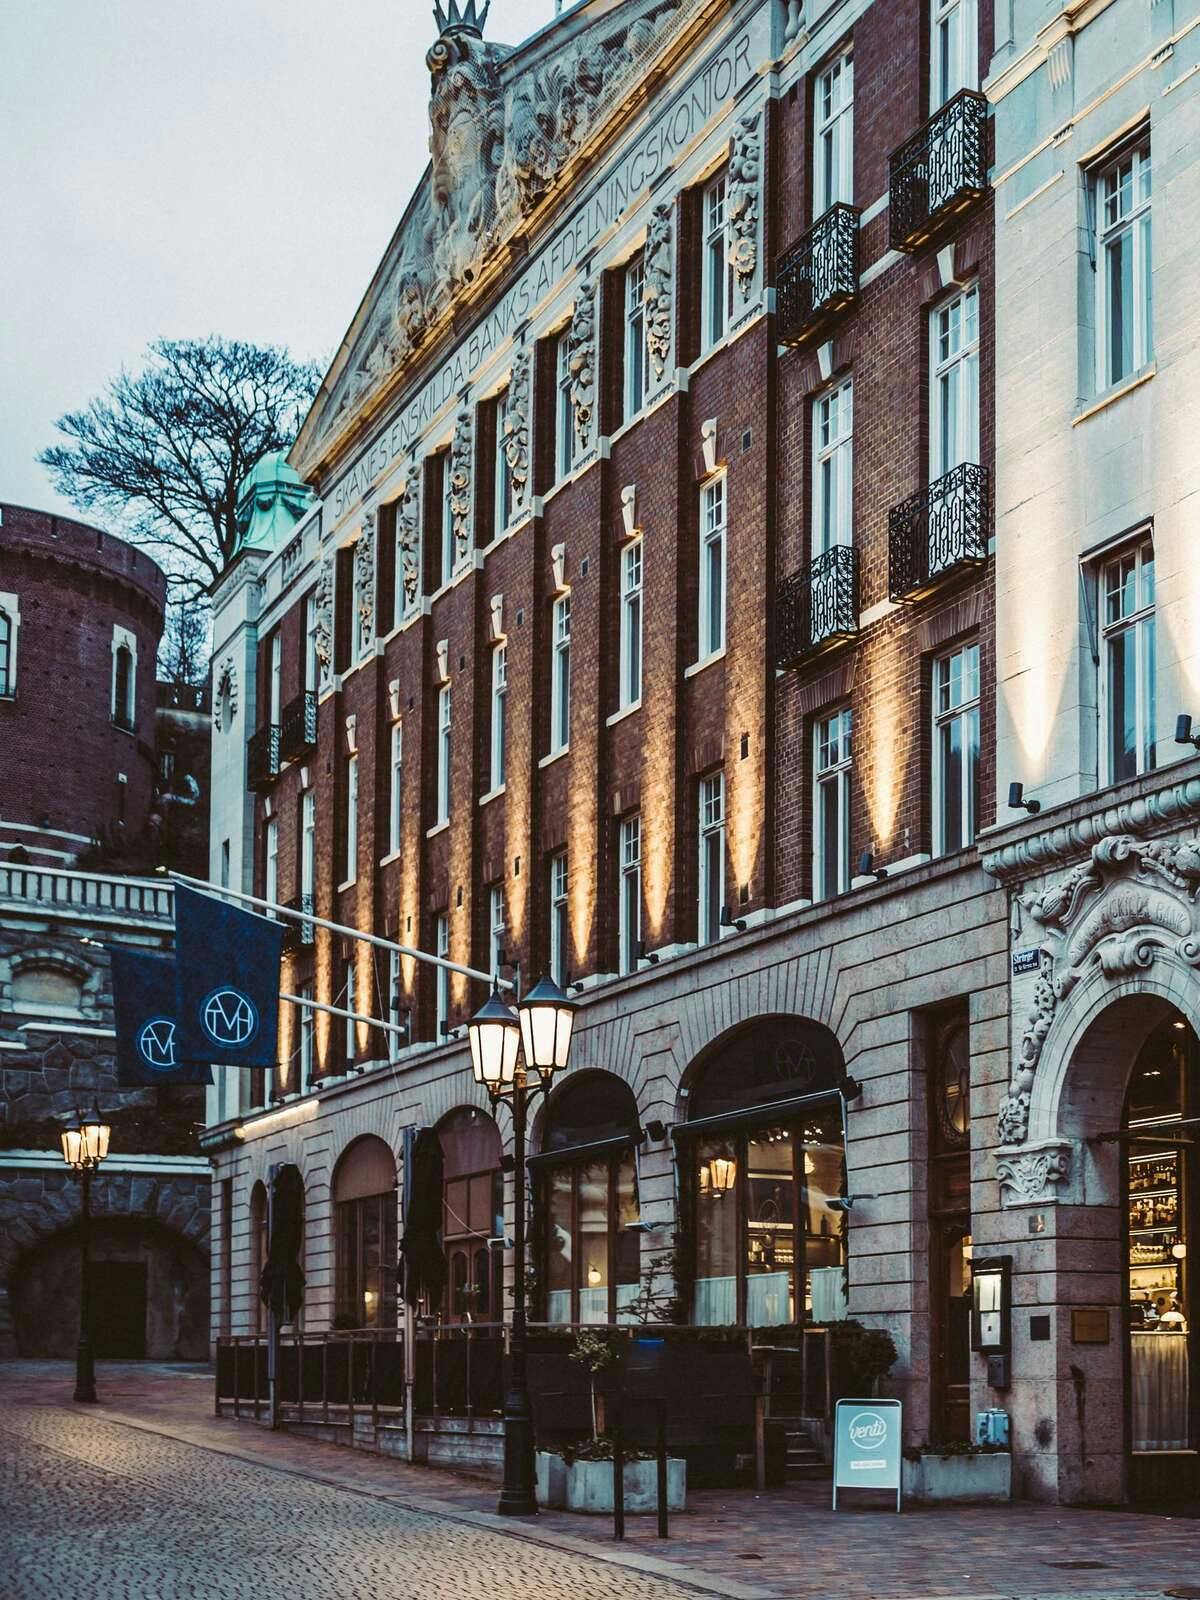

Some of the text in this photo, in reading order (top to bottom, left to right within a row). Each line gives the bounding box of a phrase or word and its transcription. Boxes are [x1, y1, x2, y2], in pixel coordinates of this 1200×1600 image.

[391, 356, 464, 458] ENSKILDA
[468, 279, 531, 373] BANKS
[535, 34, 752, 291] AFDELNINGSKONTOR
[849, 1420, 886, 1440] venti
